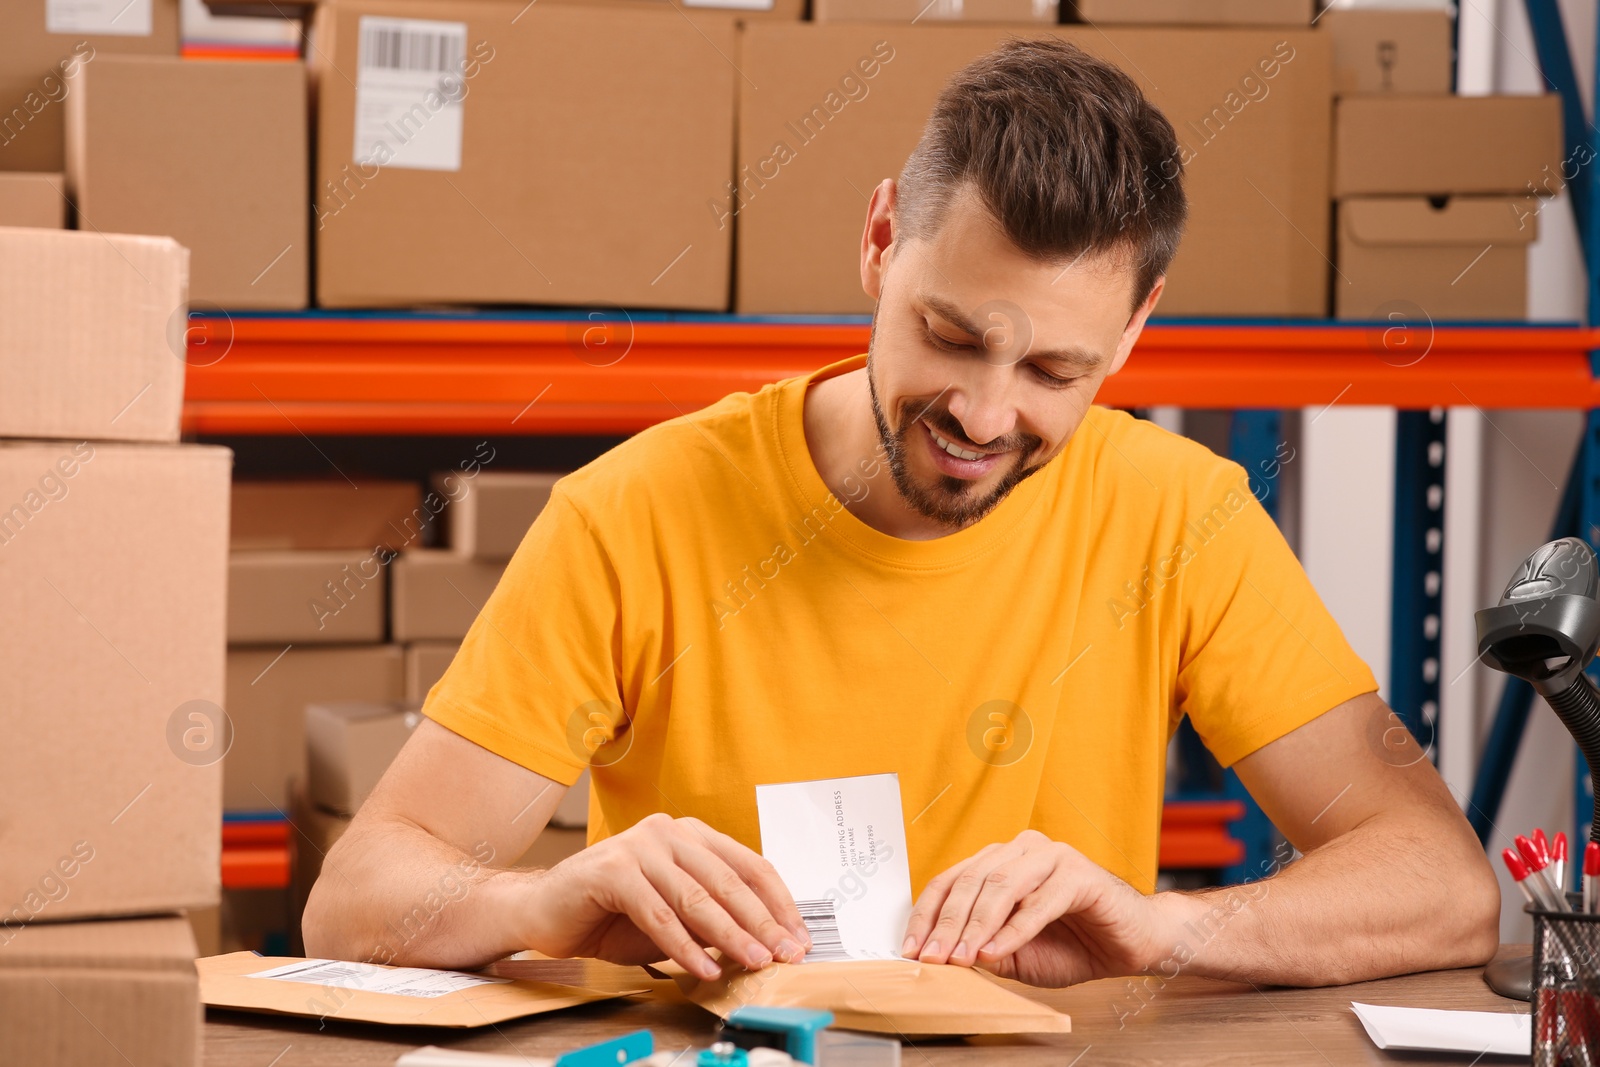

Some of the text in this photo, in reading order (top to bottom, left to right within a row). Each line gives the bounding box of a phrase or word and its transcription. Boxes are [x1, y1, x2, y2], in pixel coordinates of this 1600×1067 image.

[834, 790, 848, 867] SHIPPING ADDRESS
[867, 825, 876, 864] 1234567890
[858, 850, 866, 866] CITY
